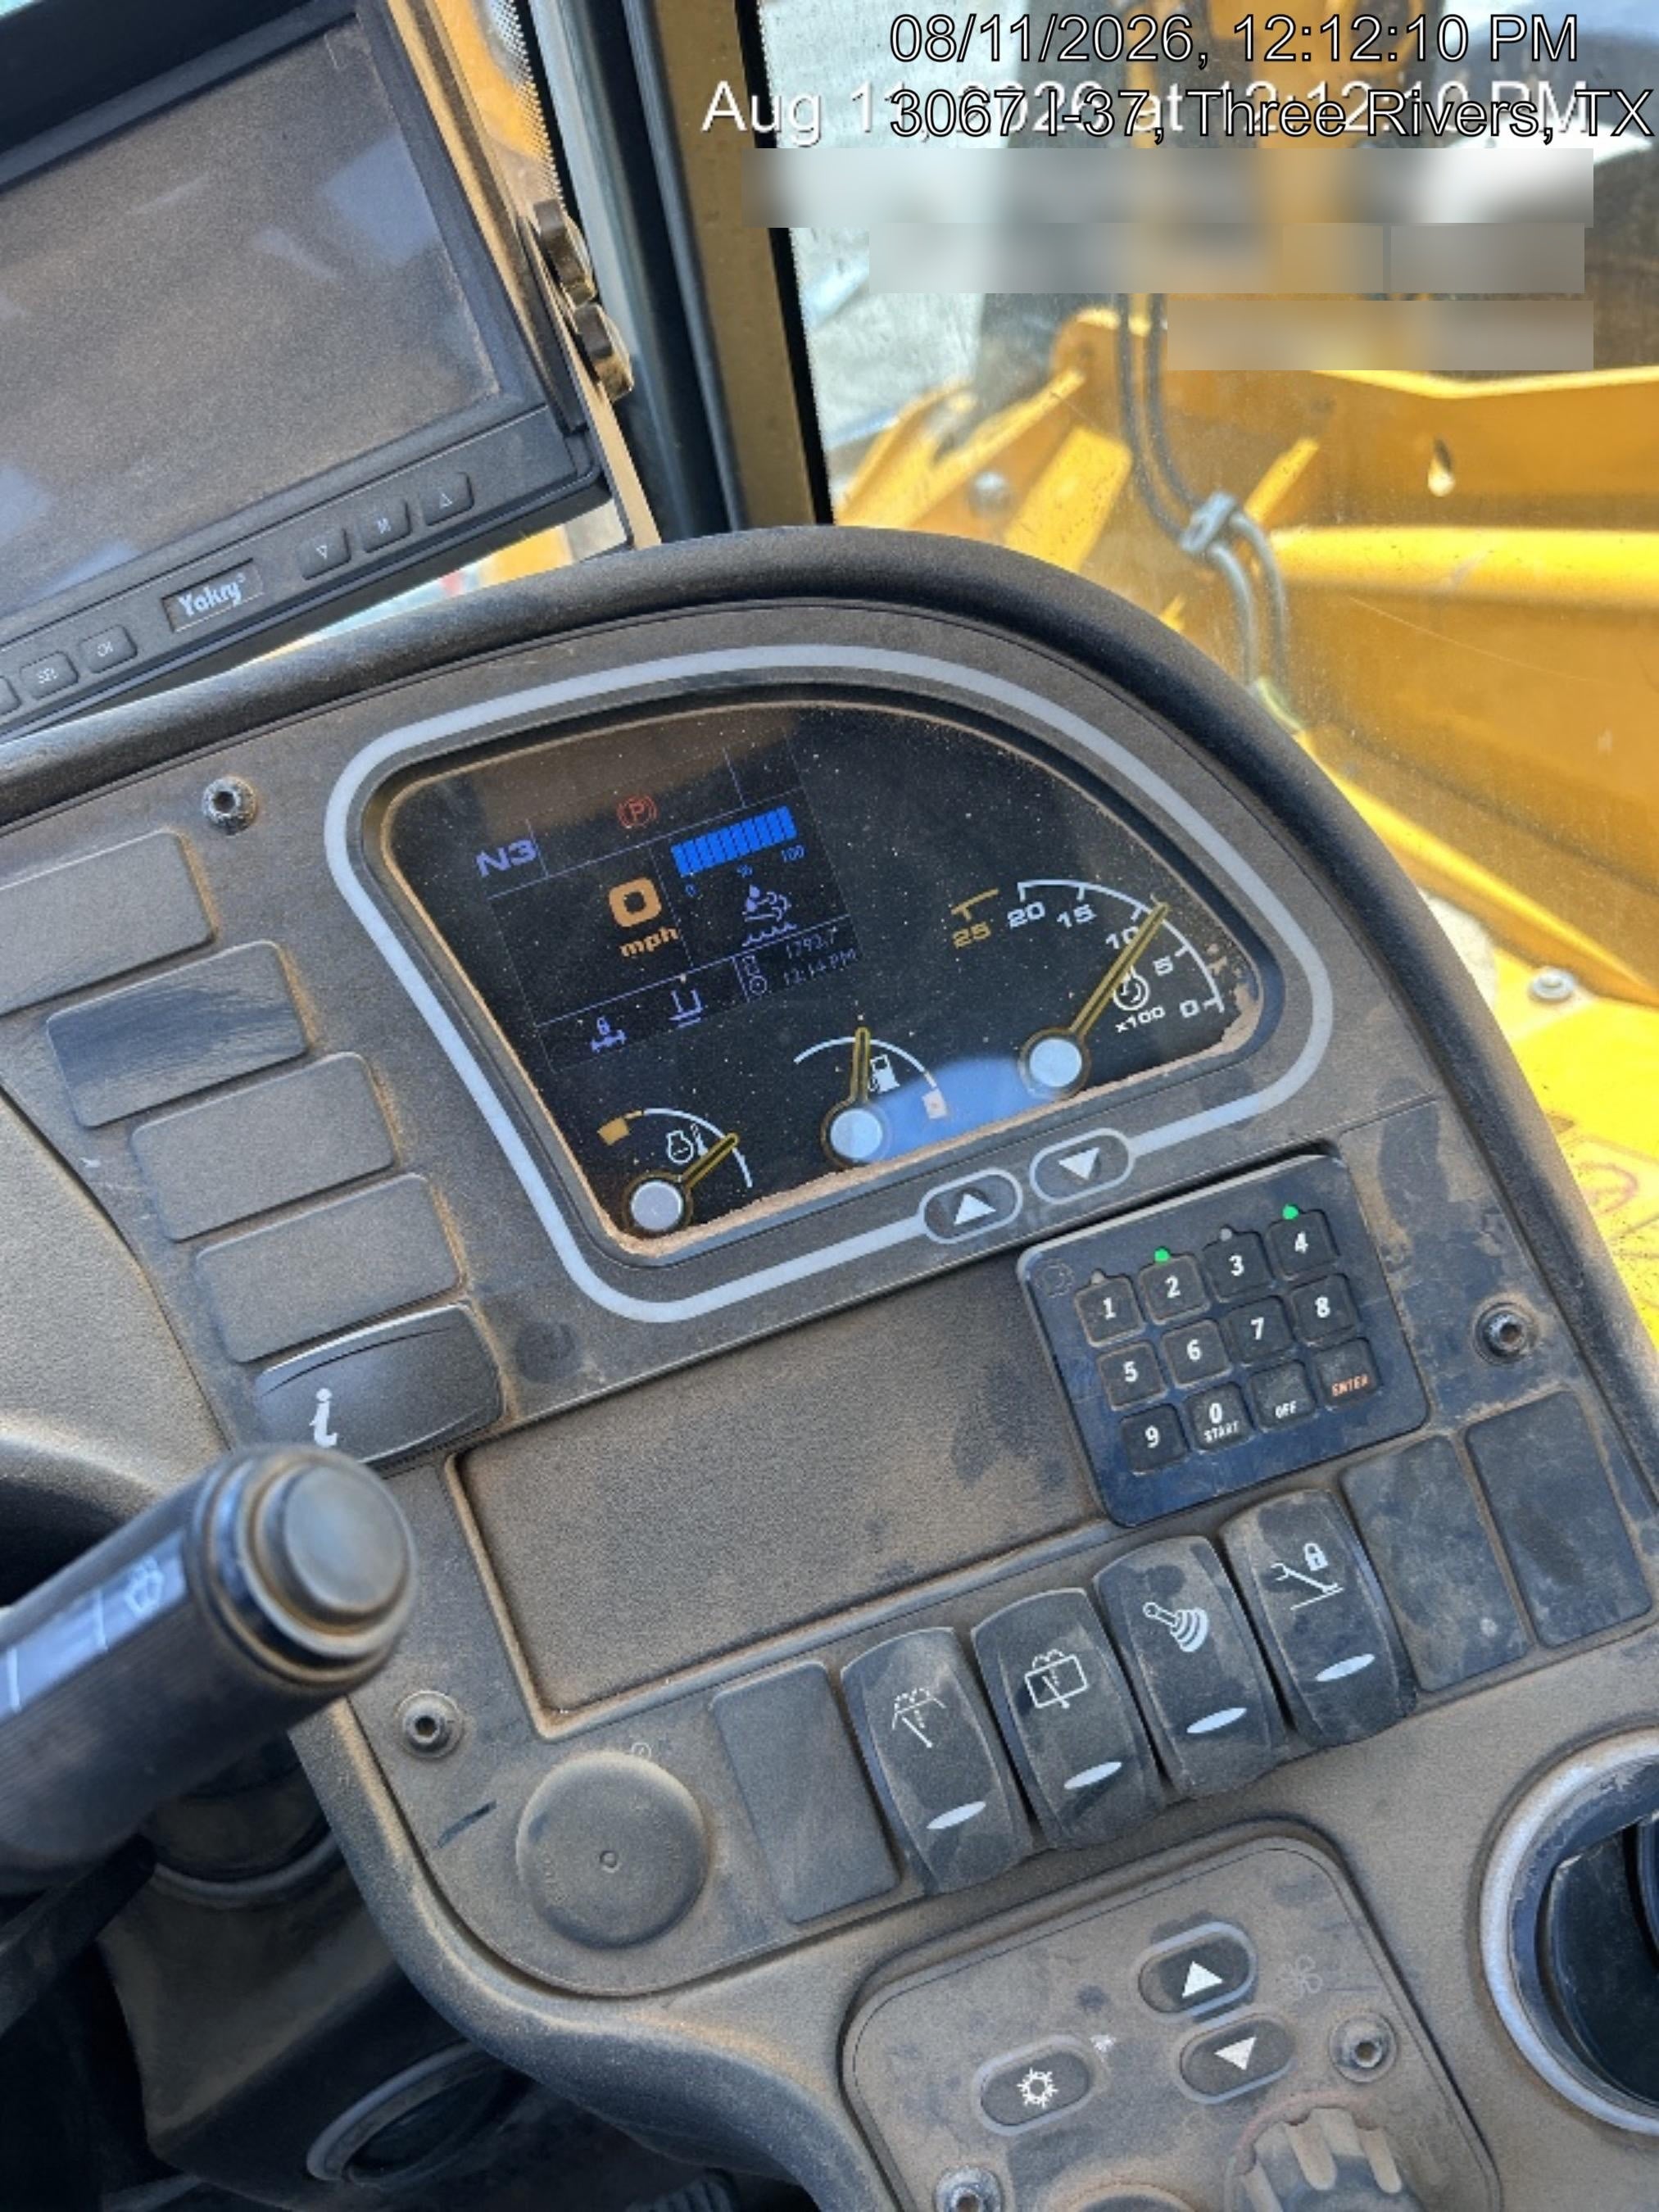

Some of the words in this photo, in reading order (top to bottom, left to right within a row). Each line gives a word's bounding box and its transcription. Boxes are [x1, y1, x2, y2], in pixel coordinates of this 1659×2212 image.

[476, 839, 537, 877] N3
[1007, 901, 1046, 929] 20
[1057, 904, 1097, 929] 15
[620, 927, 678, 957] mph
[952, 922, 991, 949] 25
[1153, 954, 1175, 977] 5
[1115, 1006, 1166, 1033] x100
[1179, 999, 1200, 1018] 0
[1294, 1232, 1308, 1254] 4
[1230, 1254, 1244, 1276] 3
[1166, 1275, 1181, 1299] 2
[1102, 1297, 1117, 1321] 1
[1315, 1296, 1331, 1319] 8
[1249, 1317, 1266, 1341] 7
[1186, 1339, 1202, 1362] 6
[1124, 1361, 1139, 1384] 5
[1331, 1374, 1369, 1398] ENTER
[1208, 1402, 1225, 1426] 0
[1275, 1400, 1298, 1421] OFF
[1145, 1426, 1160, 1449] 9
[1203, 1420, 1240, 1444] START
